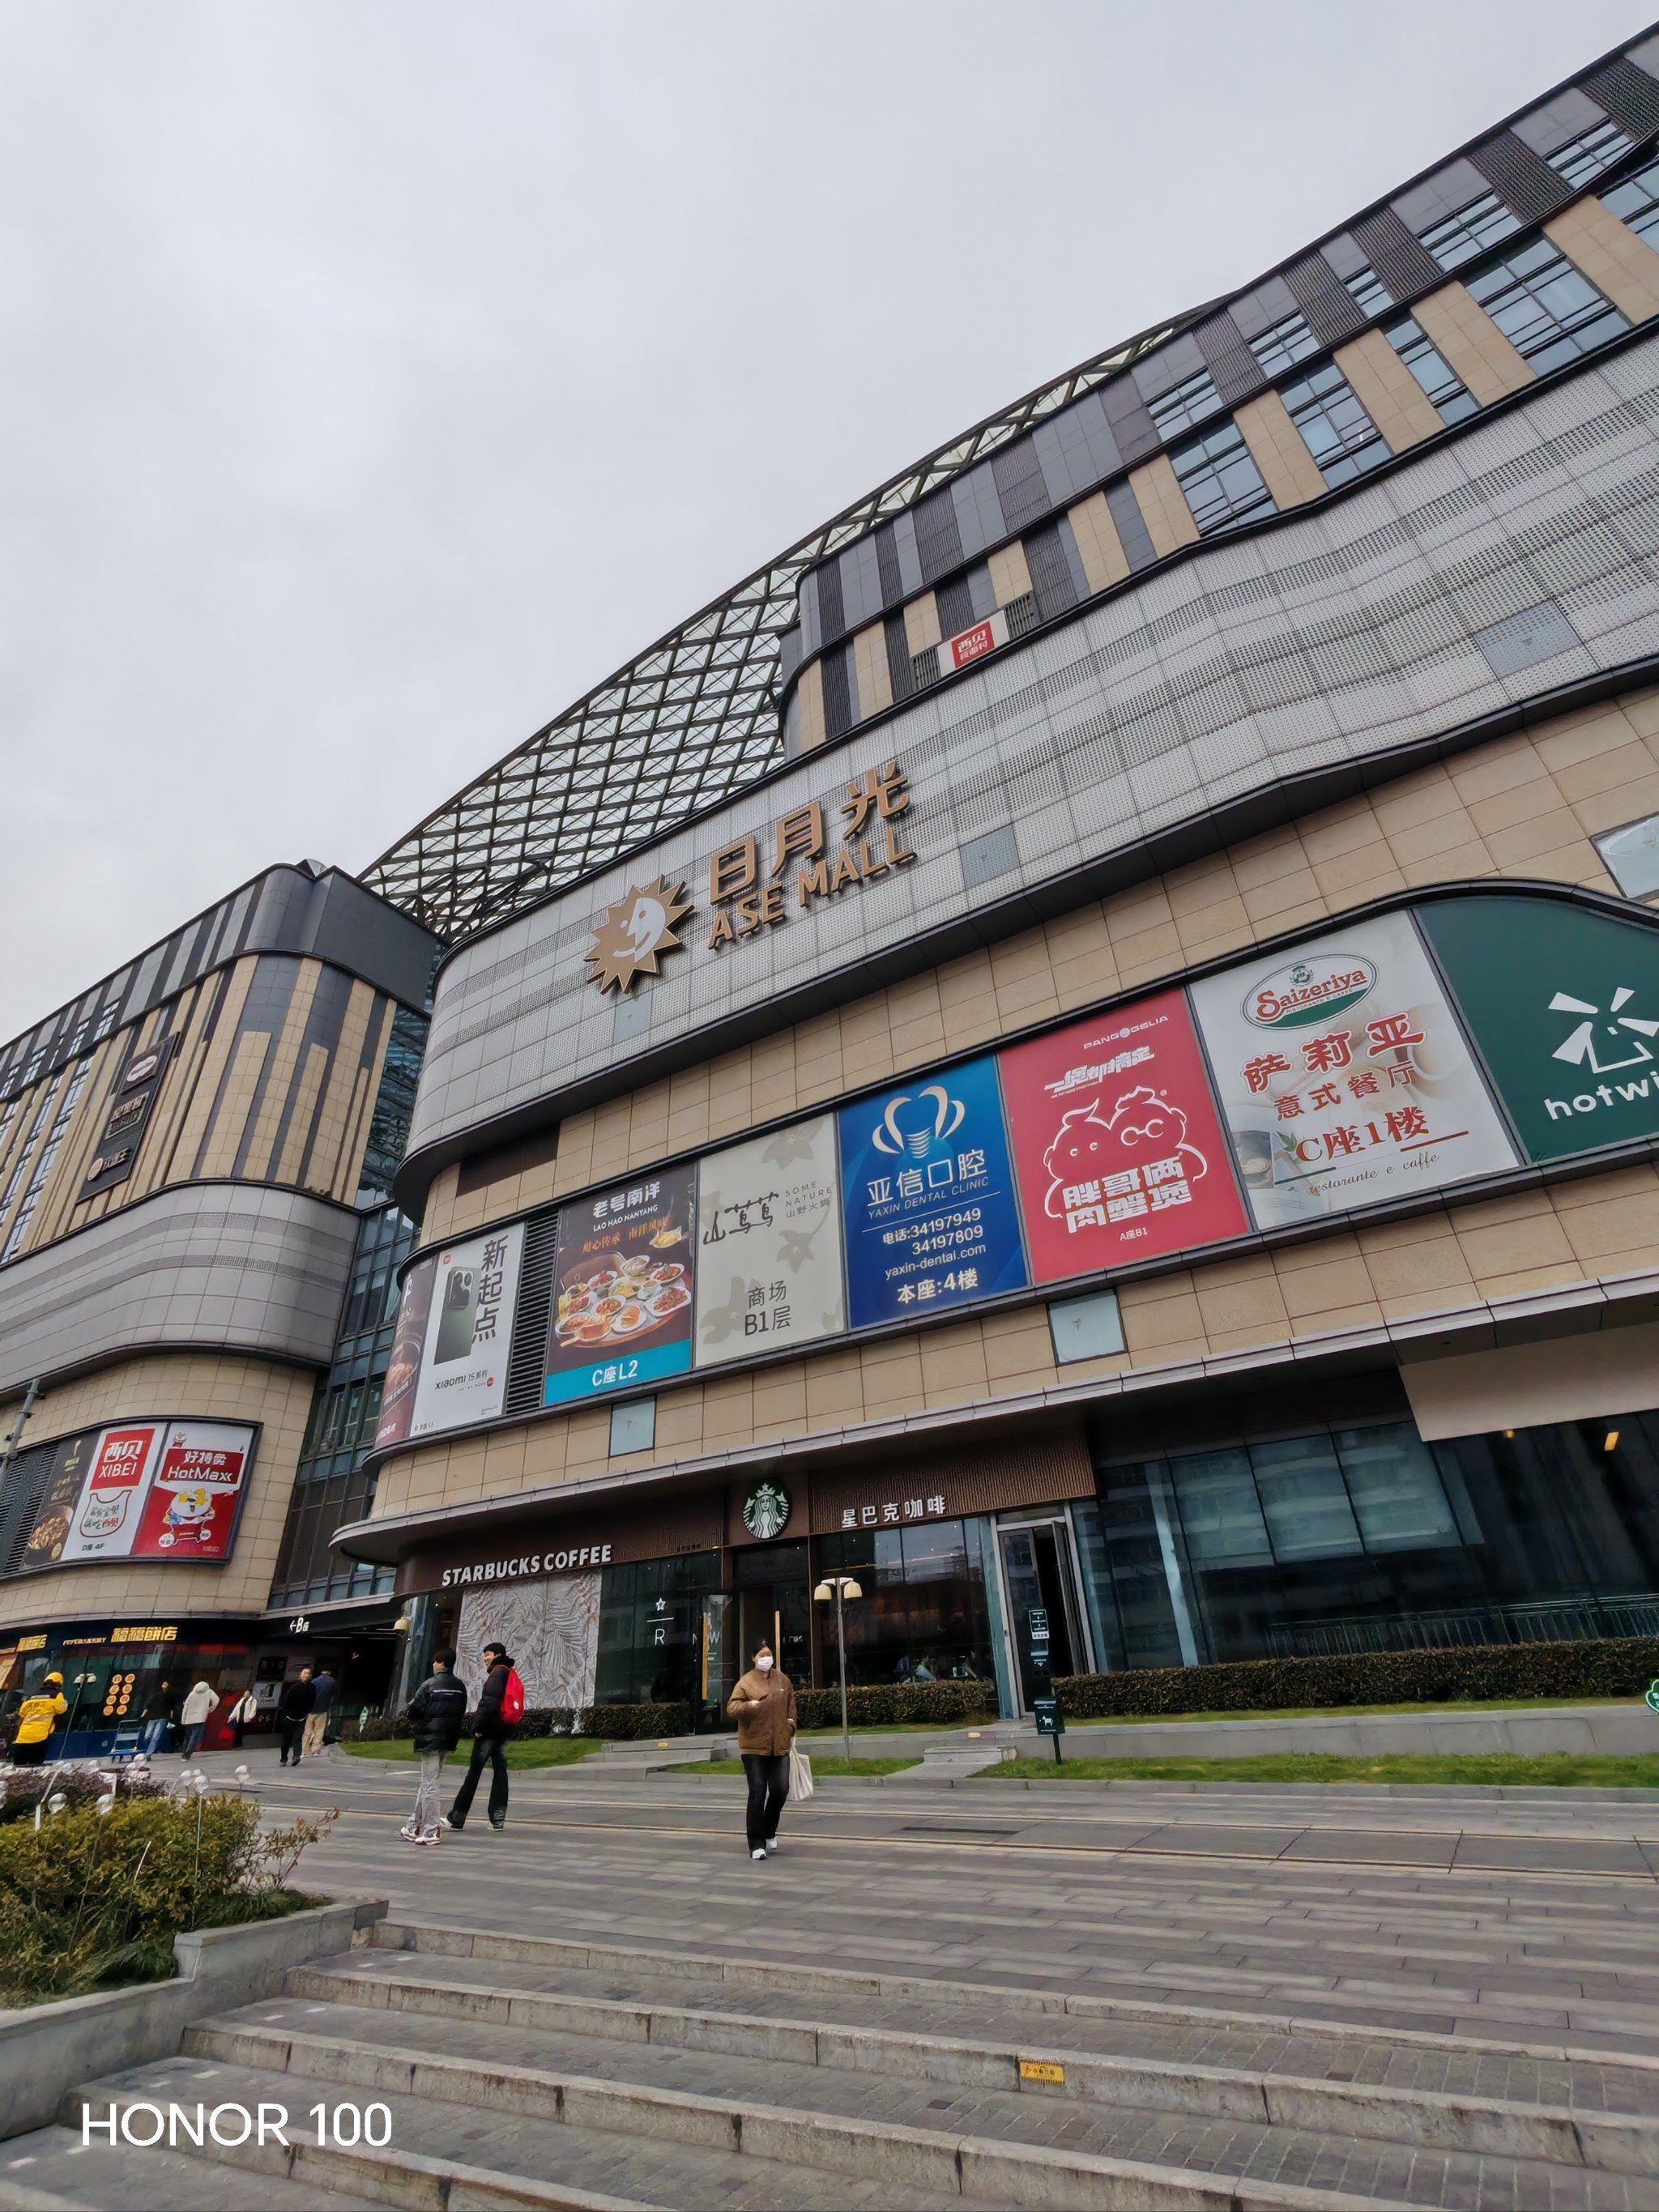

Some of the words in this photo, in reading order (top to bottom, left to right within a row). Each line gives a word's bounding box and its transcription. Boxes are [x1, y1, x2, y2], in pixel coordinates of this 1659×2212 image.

[957, 629, 987, 654] 西贝
[710, 759, 911, 905] 日月光
[708, 881, 786, 949] ASE
[798, 826, 917, 908] MALL
[1256, 970, 1367, 1021] Saizeriya
[1243, 1012, 1426, 1093] 萨莉亚
[1273, 1060, 1414, 1122] 意式餐厅
[1296, 1106, 1430, 1161] C座1楼
[867, 1149, 987, 1207] 亚信口腔
[1385, 1165, 1395, 1174] e
[1402, 1150, 1439, 1170] caffe
[592, 1181, 662, 1218] 老号南洋
[784, 1180, 817, 1197] SOME
[786, 1186, 833, 1207] NATURE
[868, 1202, 901, 1220] YAXIN
[904, 1190, 947, 1209] DENTAL
[951, 1176, 989, 1196] CLINIC
[1062, 1156, 1185, 1209] 胖哥俩
[593, 1221, 608, 1232] LAO
[608, 1215, 624, 1227] HAO
[624, 1204, 659, 1221] NANYANG
[1066, 1179, 1192, 1234] 肉蟹煲
[883, 1208, 981, 1245] 电话:34197949
[911, 1225, 983, 1255] 34197809
[1120, 1226, 1149, 1242] A座B1
[885, 1243, 987, 1281] yaxin-dental.com
[471, 1234, 509, 1345] 新起点
[748, 1280, 787, 1309] 商场
[897, 1267, 979, 1304] 本座:4楼
[744, 1305, 792, 1336] B1层
[592, 1359, 638, 1387] C座L2
[104, 1439, 143, 1463] 西贝
[183, 1450, 227, 1466] 好特卖
[98, 1461, 137, 1479] XIBEI
[842, 1494, 946, 1528] 星巴克咖啡
[441, 1555, 540, 1587] STARBUCKS
[544, 1544, 612, 1571] COFFEE
[111, 1626, 178, 1643] 福福餅店
[296, 1617, 309, 1633] B座
[655, 1628, 665, 1646] R
